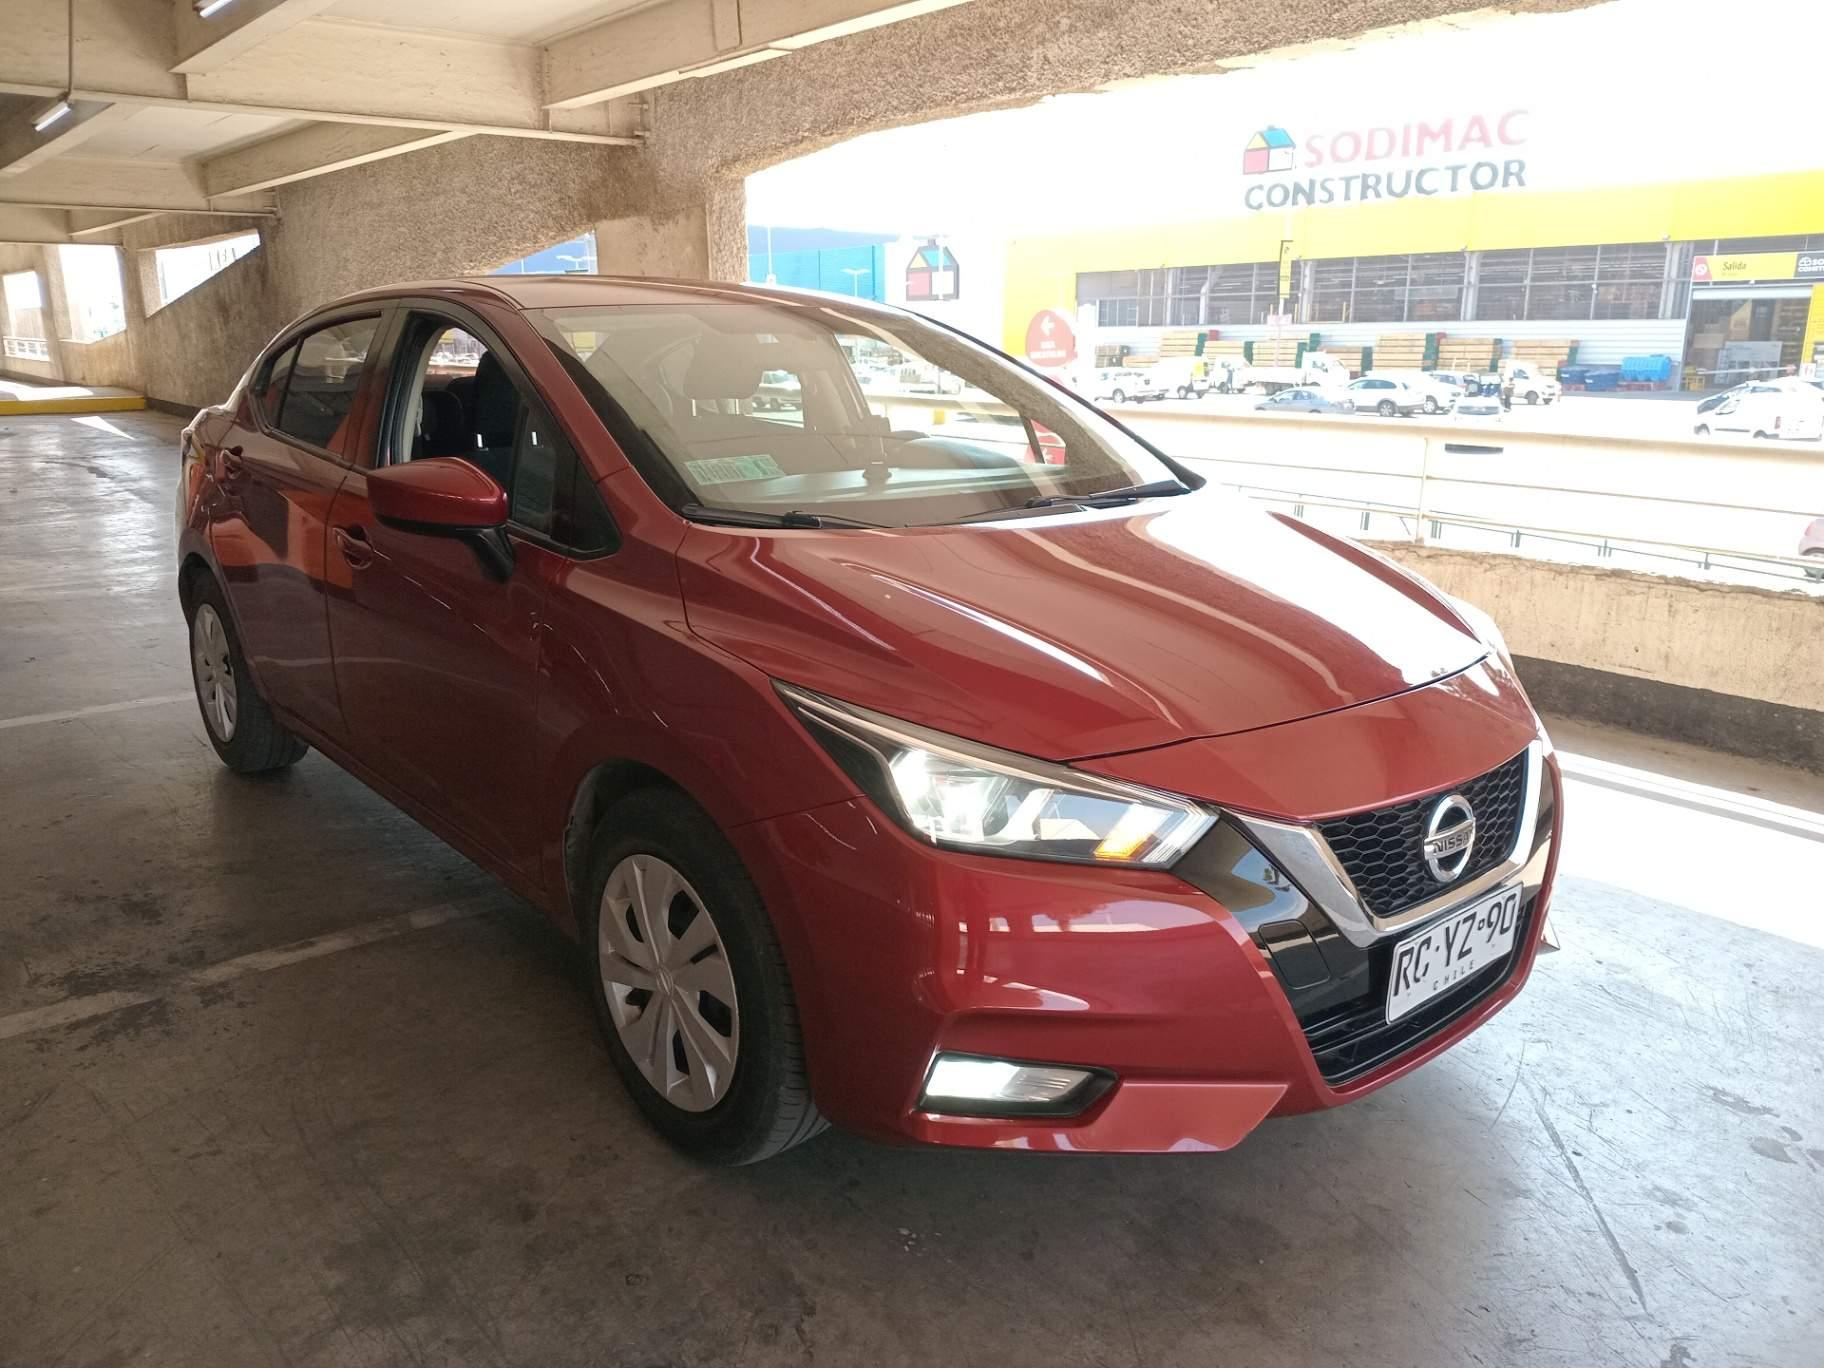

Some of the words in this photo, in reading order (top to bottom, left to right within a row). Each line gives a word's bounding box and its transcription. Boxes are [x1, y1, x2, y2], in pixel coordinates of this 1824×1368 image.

[1303, 108, 1529, 169] SODIMAC
[1244, 158, 1527, 211] CONSTRUCTOR
[1722, 261, 1748, 272] Salida
[1432, 959, 1475, 991] CHILE
